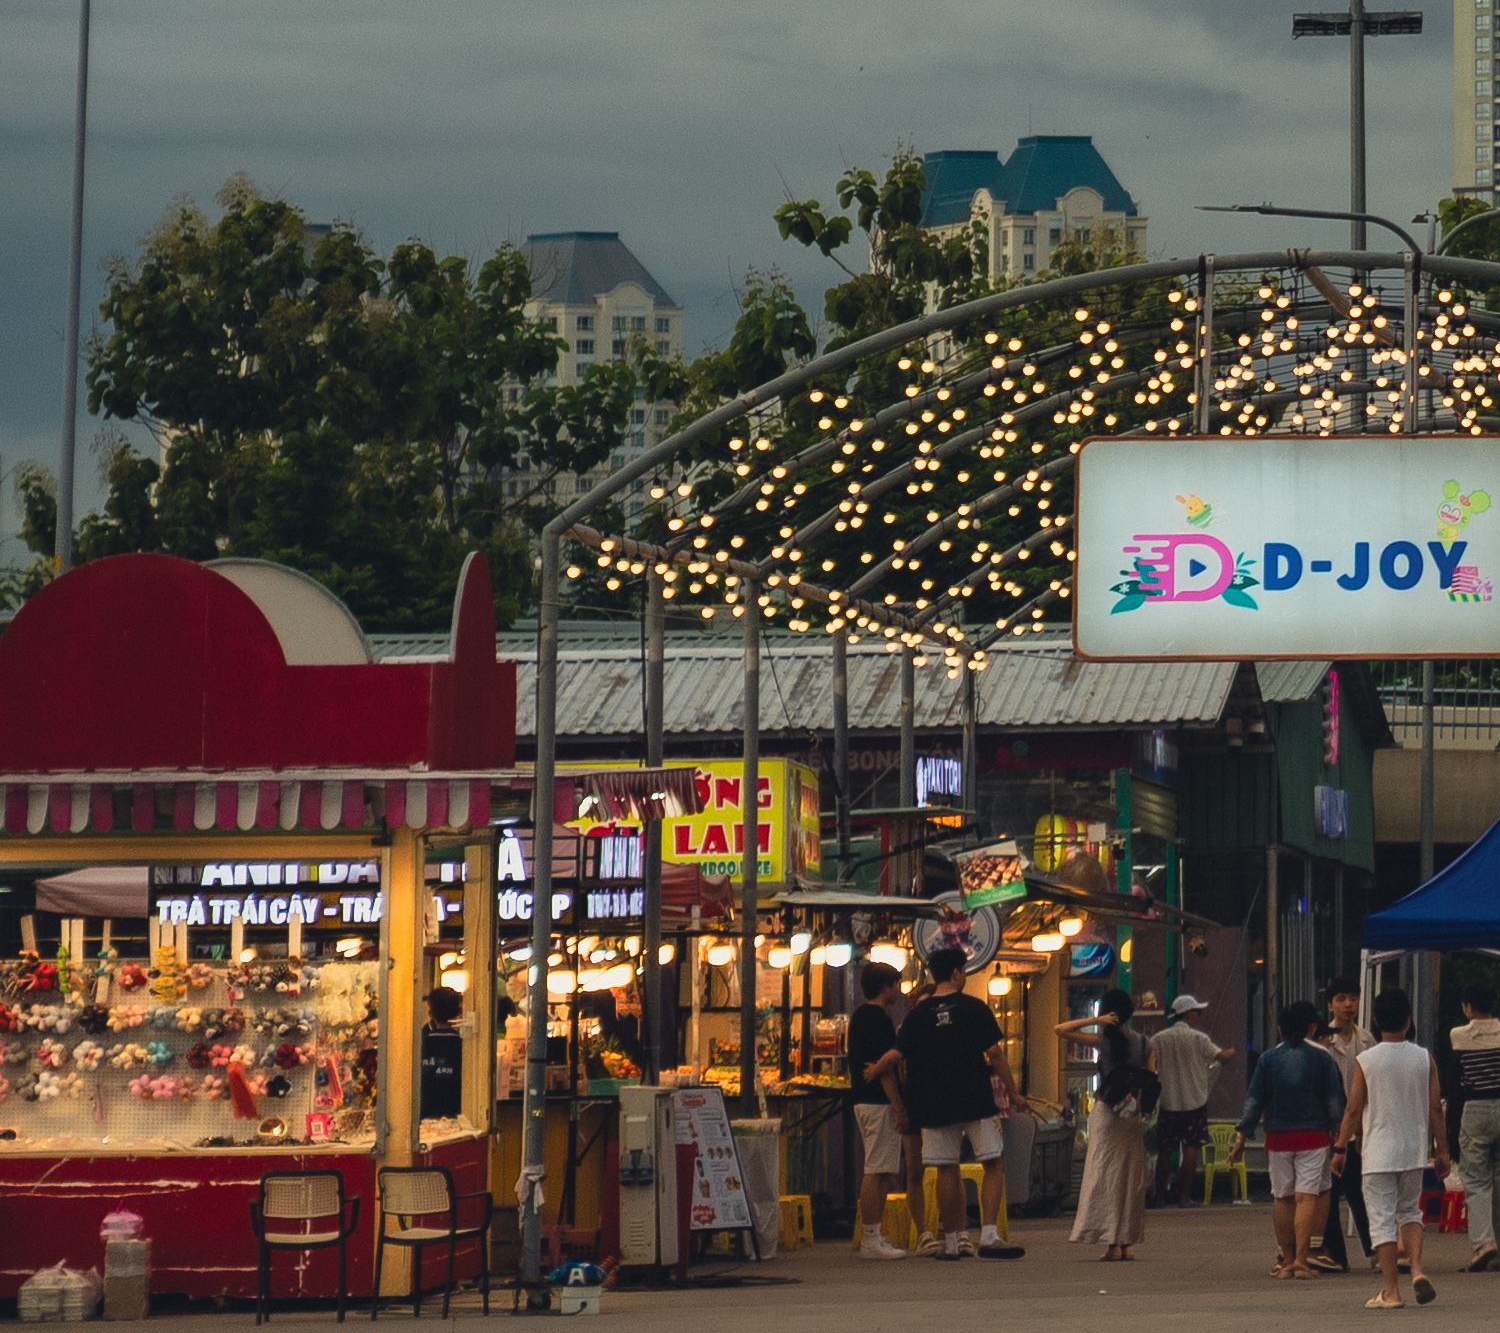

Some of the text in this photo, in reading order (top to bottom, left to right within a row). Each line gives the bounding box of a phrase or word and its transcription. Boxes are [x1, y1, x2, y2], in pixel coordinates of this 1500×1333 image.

[1263, 540, 1468, 591] D-JOY
[156, 894, 205, 926] TRÀ
[209, 891, 267, 925] TRÁI
[270, 890, 319, 925] CÂY
